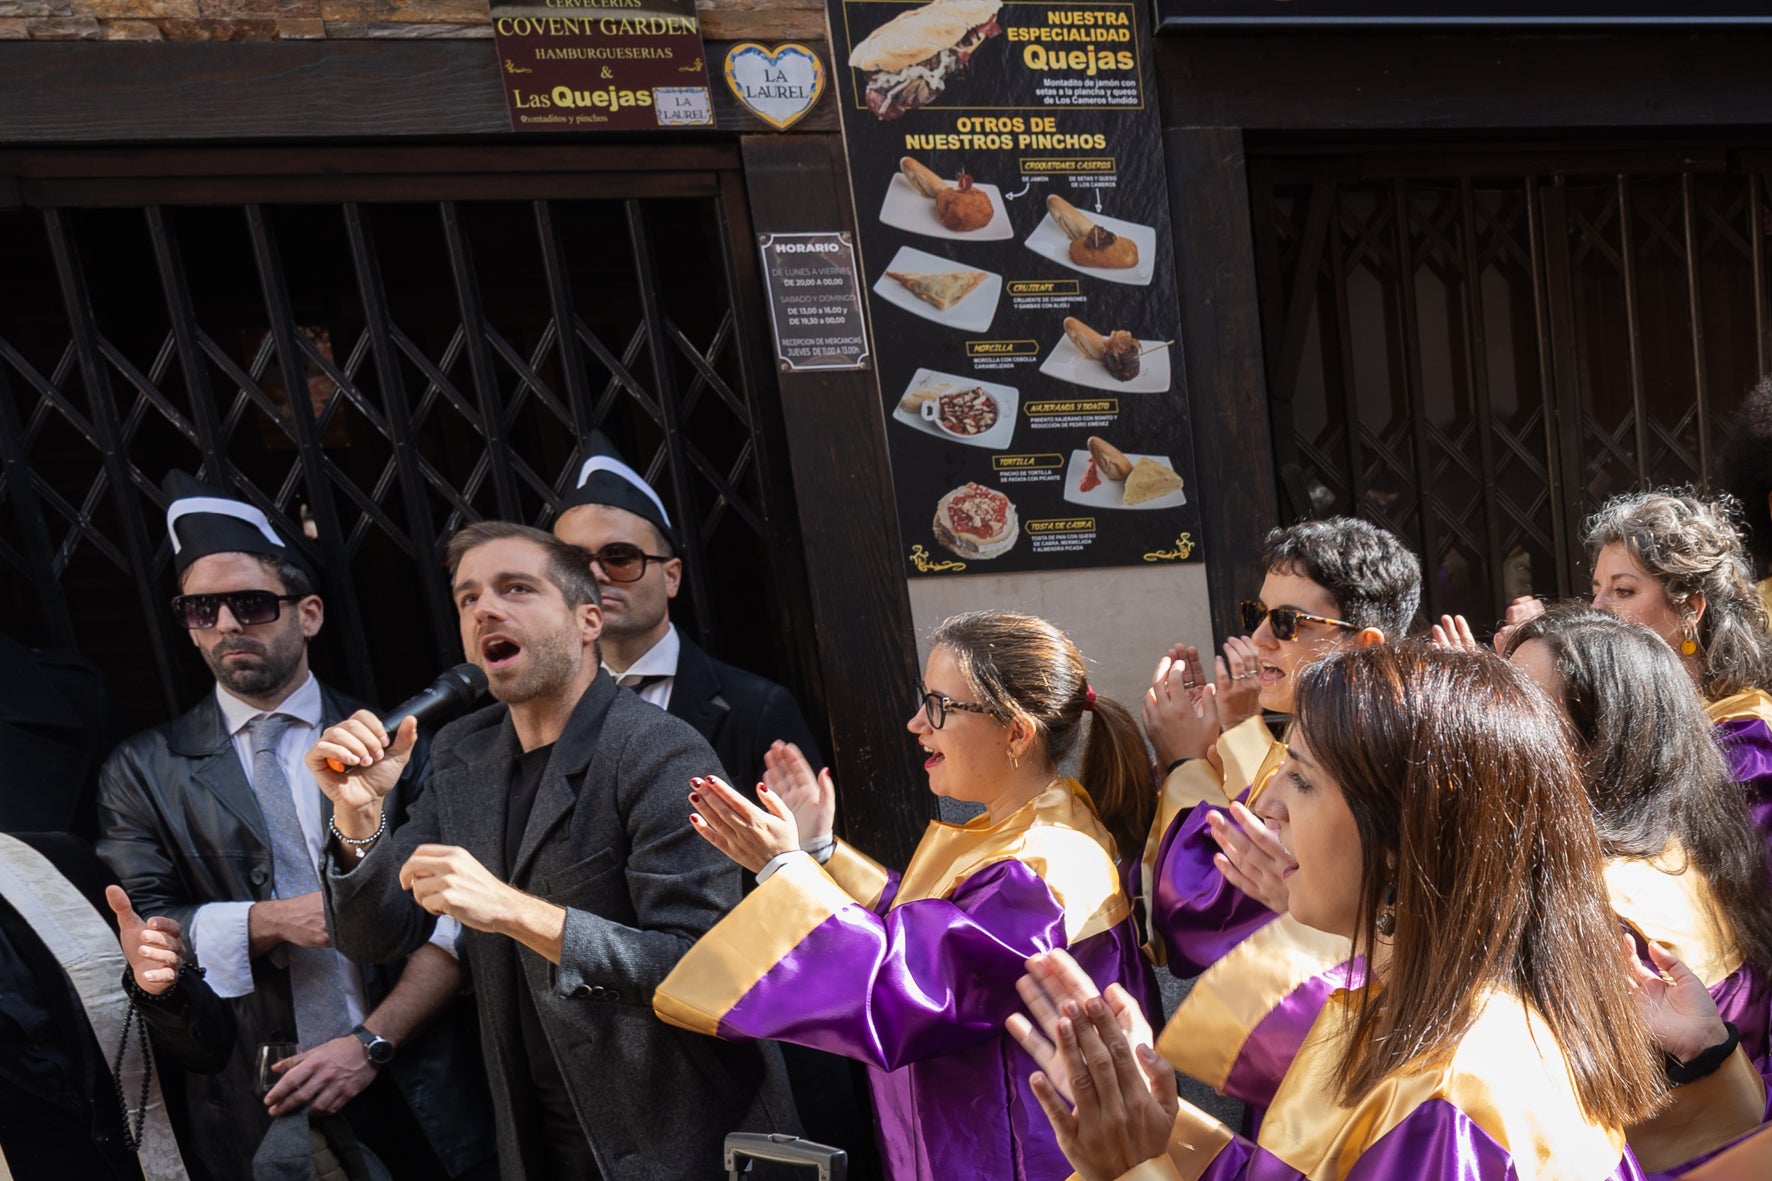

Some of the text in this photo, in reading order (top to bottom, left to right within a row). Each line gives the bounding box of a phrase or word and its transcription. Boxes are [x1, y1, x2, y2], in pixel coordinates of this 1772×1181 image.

[546, 0, 642, 8] CERVECERIAS
[1047, 11, 1129, 25] NUESTRA
[498, 16, 698, 36] COVENT GARDEN
[1007, 27, 1130, 42] ESPECIALIDAD
[535, 48, 673, 60] HAMBURGUESERIAS
[1023, 44, 1135, 76] Quejas
[600, 66, 614, 79] &
[764, 69, 788, 83] LA
[1043, 78, 1082, 87] Montadito
[1084, 78, 1095, 87] de
[1095, 78, 1120, 88] jamón
[746, 85, 810, 99] LAUREL
[1074, 88, 1105, 98] plancha
[1106, 89, 1111, 98] y
[1113, 88, 1137, 97] queso
[513, 85, 652, 112] Las Quejas
[676, 97, 692, 107] LA
[1044, 96, 1138, 104] de Los Cameros fundido
[569, 116, 574, 125] y
[576, 113, 608, 125] pinchos
[664, 110, 707, 120] LAUREL
[957, 117, 1056, 132] OTROS DE
[905, 134, 1106, 150] NUESTROS PINCHOS
[775, 243, 840, 253] HORARIO
[772, 267, 851, 277] DE LUNES A VIERNES
[843, 308, 848, 316] y
[1000, 457, 1035, 465] TORTILLA
